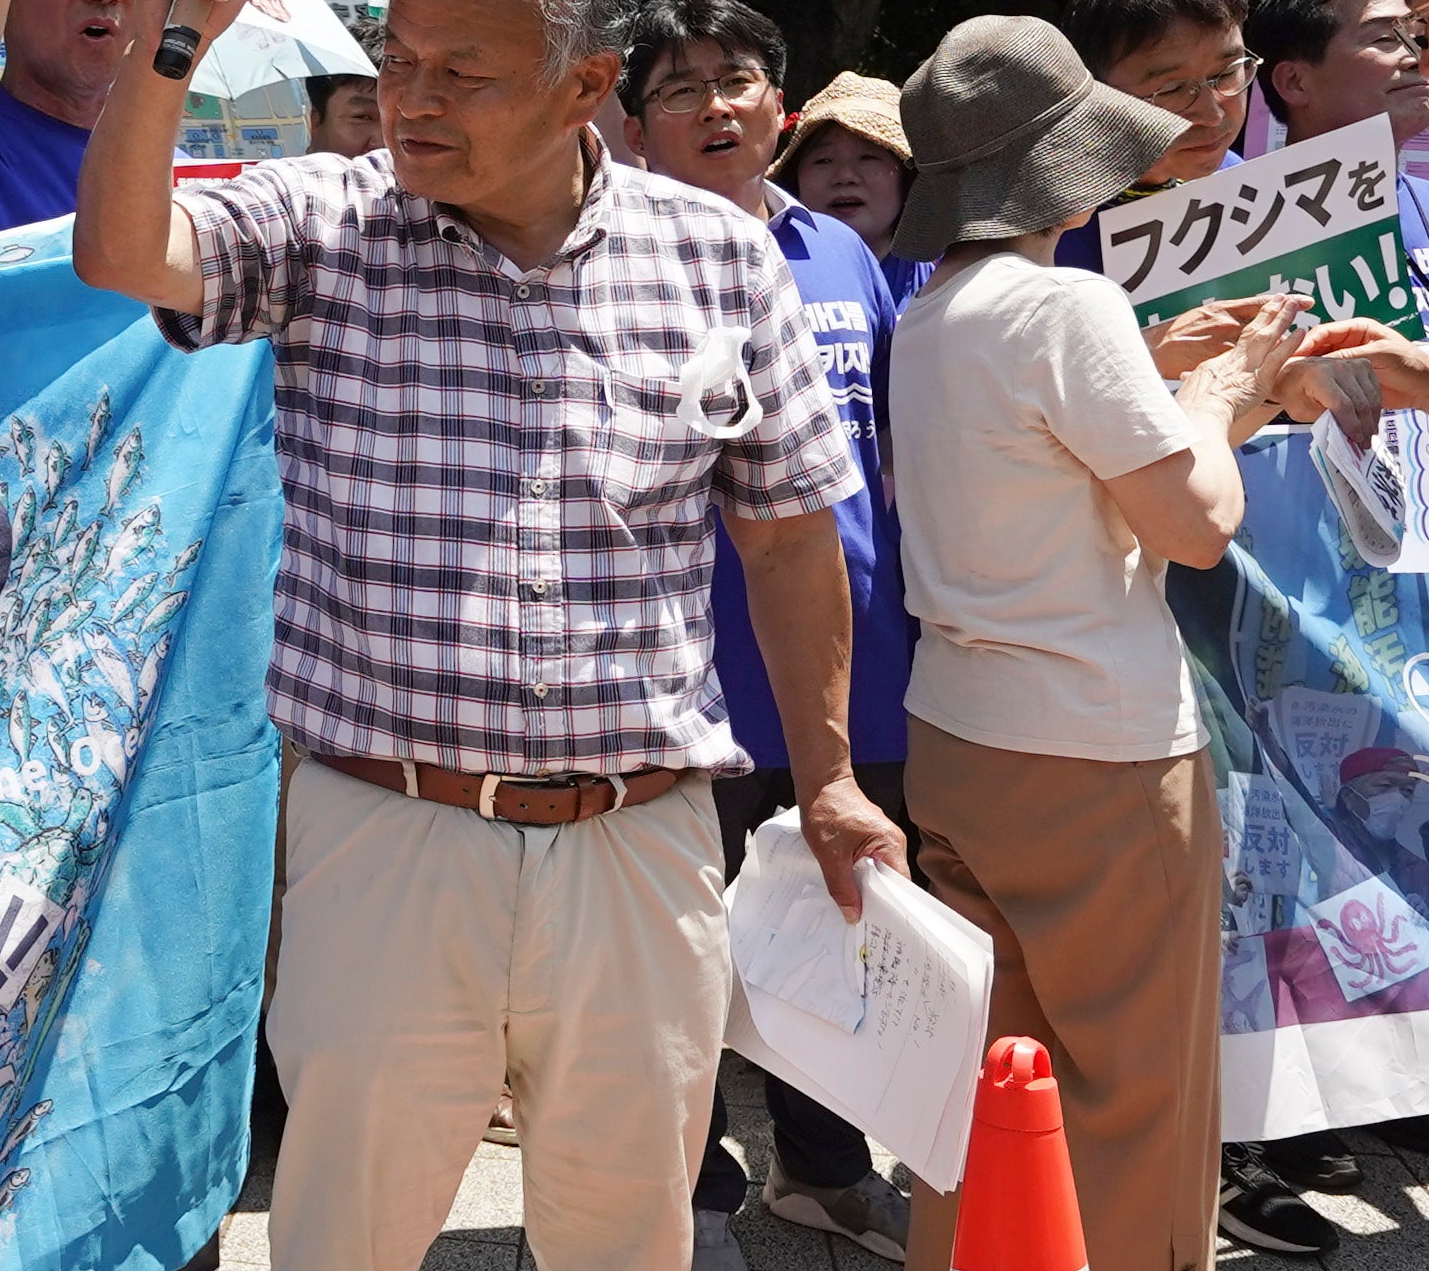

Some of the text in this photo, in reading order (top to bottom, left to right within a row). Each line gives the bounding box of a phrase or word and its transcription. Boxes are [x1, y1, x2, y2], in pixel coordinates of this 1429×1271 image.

[1110, 156, 1389, 294] フクシマを
